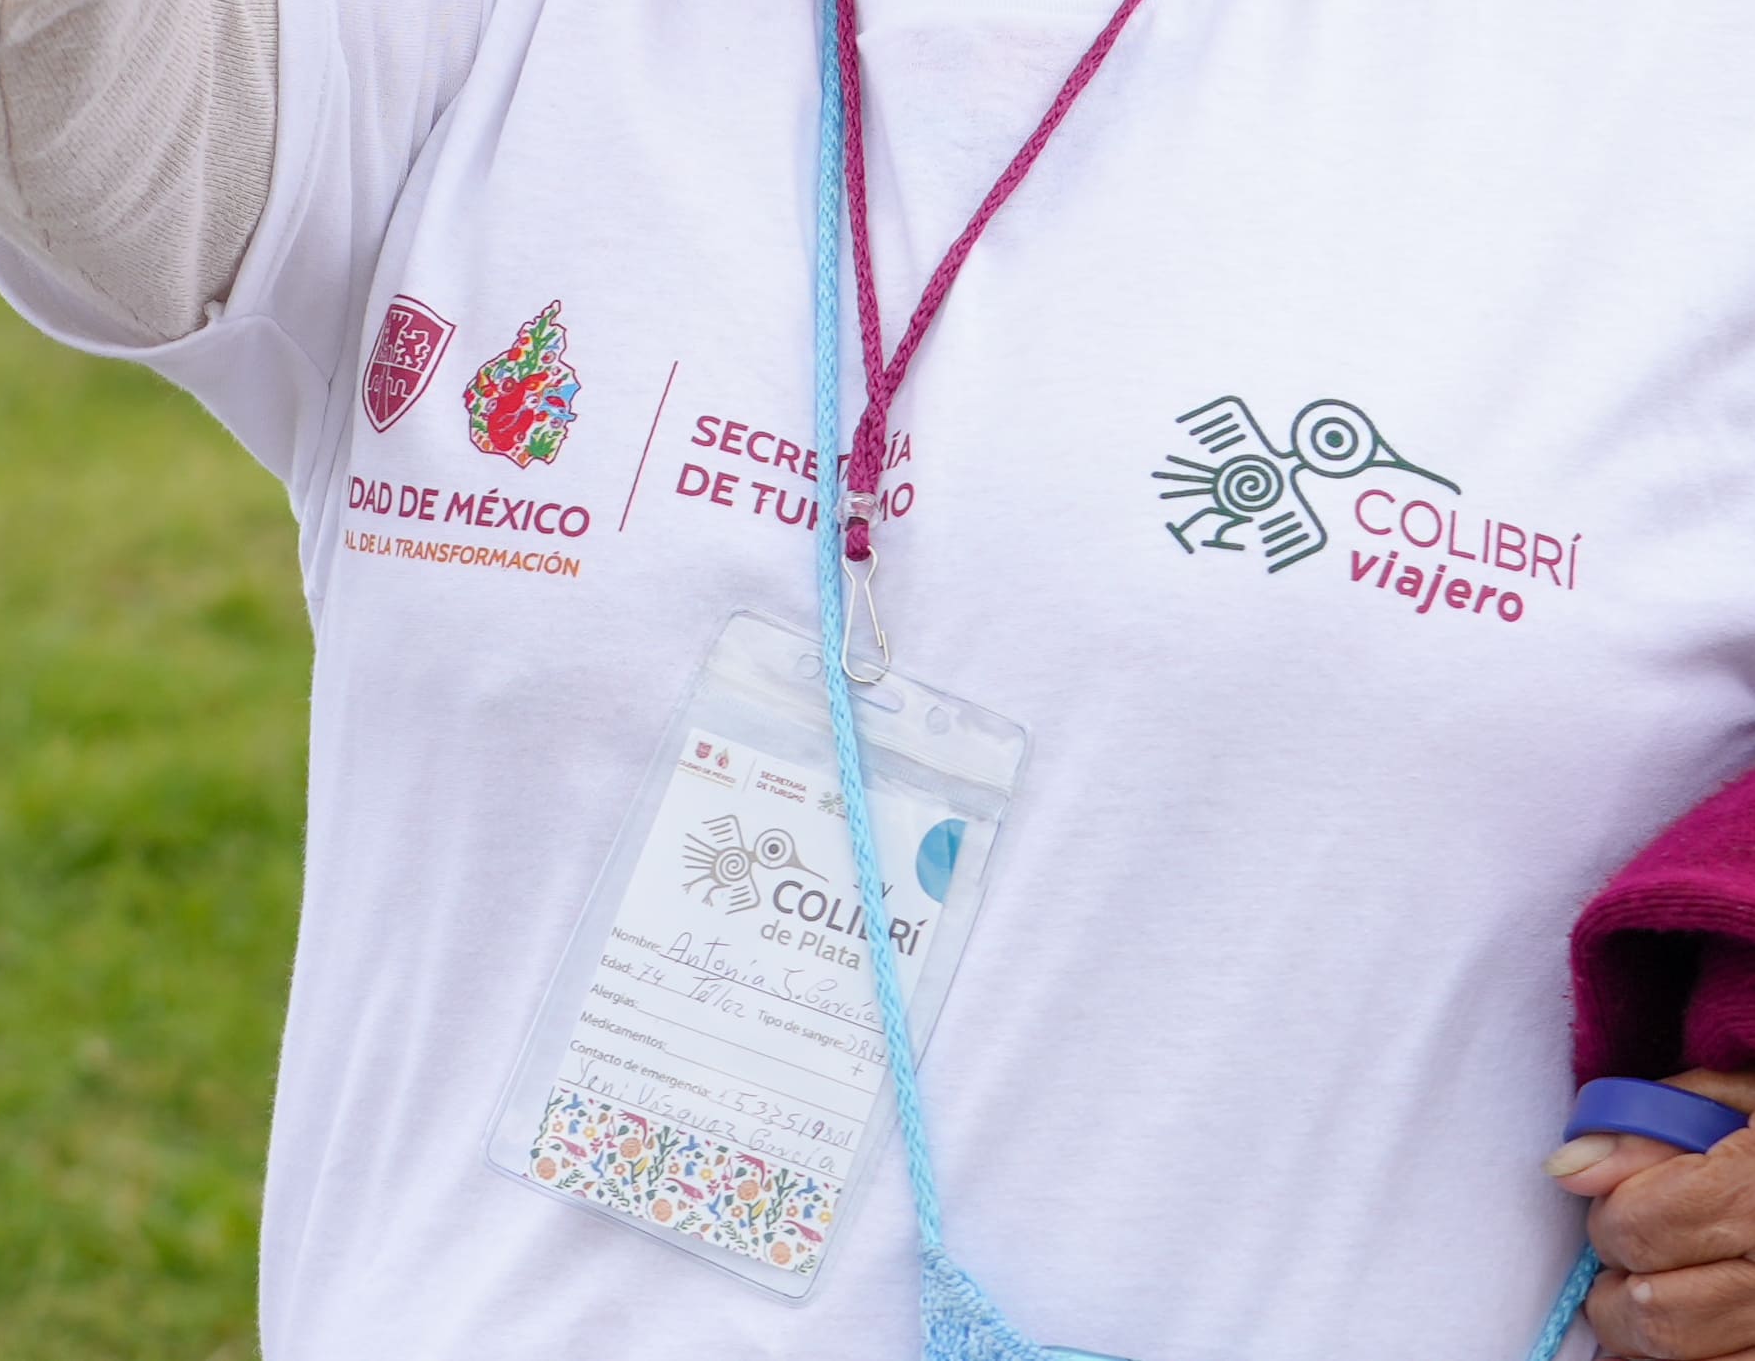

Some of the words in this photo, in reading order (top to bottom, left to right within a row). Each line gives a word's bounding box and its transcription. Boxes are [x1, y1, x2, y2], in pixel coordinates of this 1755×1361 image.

[348, 475, 393, 515] DAD
[398, 485, 440, 521] DE
[443, 487, 591, 538] MÉXICO
[675, 462, 741, 507] DE
[359, 532, 376, 553] DE
[377, 534, 392, 556] LA
[395, 538, 581, 578] TRANSFORMACIÓN
[1354, 488, 1583, 590] COLIBRÍ
[1349, 549, 1524, 623] viajero
[772, 880, 929, 956] COLIRÍ
[760, 919, 793, 946] de
[797, 931, 861, 970] Plata
[758, 1009, 784, 1027] Tipo
[783, 1020, 800, 1035] de
[569, 1039, 622, 1067] Contacto
[623, 1059, 639, 1073] de
